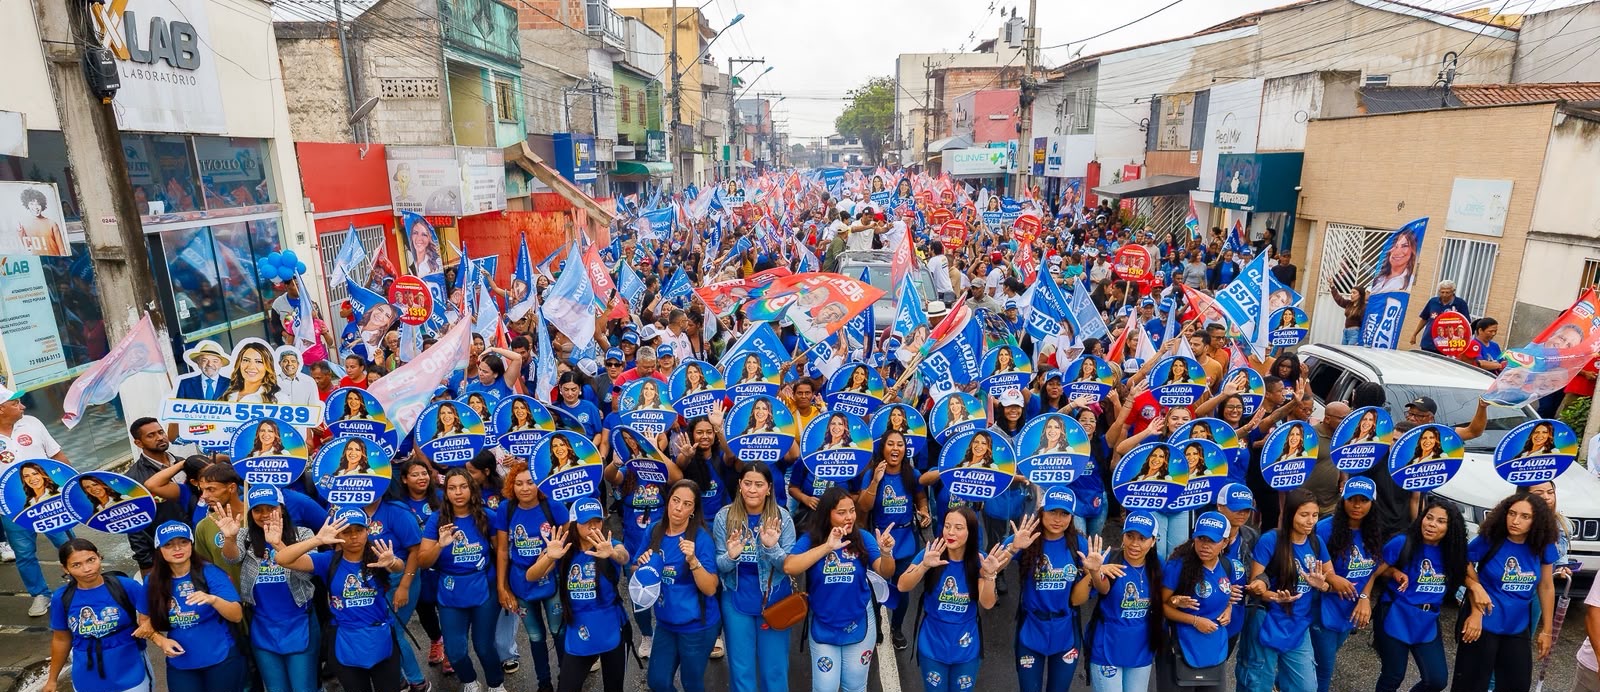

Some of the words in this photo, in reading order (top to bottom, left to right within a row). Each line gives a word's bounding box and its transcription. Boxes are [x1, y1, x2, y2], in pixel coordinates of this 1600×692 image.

[123, 68, 196, 86] LABORATÓRIO
[954, 152, 989, 162] CLINVET
[1228, 280, 1259, 320] 5578
[408, 306, 427, 316] 1310
[1273, 337, 1298, 346] 55789
[1448, 340, 1466, 348] 1310
[990, 376, 1019, 384] CLAUDIA
[682, 394, 714, 406] CLAUDIA
[837, 394, 868, 404] CLAUDIA
[172, 404, 232, 415] CLAUDIA
[235, 404, 310, 422] 55789
[836, 404, 866, 415] 55789
[189, 424, 208, 432] LULA
[432, 438, 470, 448] CLAUDIA
[508, 434, 542, 442] CLAUDIA
[1341, 446, 1375, 454] CLAUDIA
[435, 450, 472, 462] 55789
[740, 451, 777, 460] 55789
[246, 460, 289, 468] CLAUDIA
[1273, 463, 1305, 472] CLAUDIA
[1339, 460, 1371, 468] 55789
[1405, 462, 1446, 475] CLAUDIA
[1511, 459, 1556, 468] CLAUDIA
[817, 466, 855, 475] 55789
[248, 474, 289, 483] 55789
[550, 471, 588, 486] CLAUDIA
[639, 472, 663, 481] 55789
[954, 471, 994, 482] CLAUDIA
[1032, 472, 1071, 481] 55789
[1273, 476, 1302, 486] 55789
[1510, 472, 1552, 481] 55789
[1406, 476, 1444, 488] 55789
[555, 483, 592, 500] 55789
[952, 484, 992, 496] 55789
[1127, 484, 1168, 493] CLAUDIA
[331, 492, 371, 502] 55789
[1125, 497, 1163, 508] 55789
[26, 502, 63, 518] CLAUD
[97, 503, 139, 522] CLAUDIA
[109, 515, 149, 532] 55789
[1350, 570, 1371, 578] 55789
[941, 604, 966, 612] 55789
